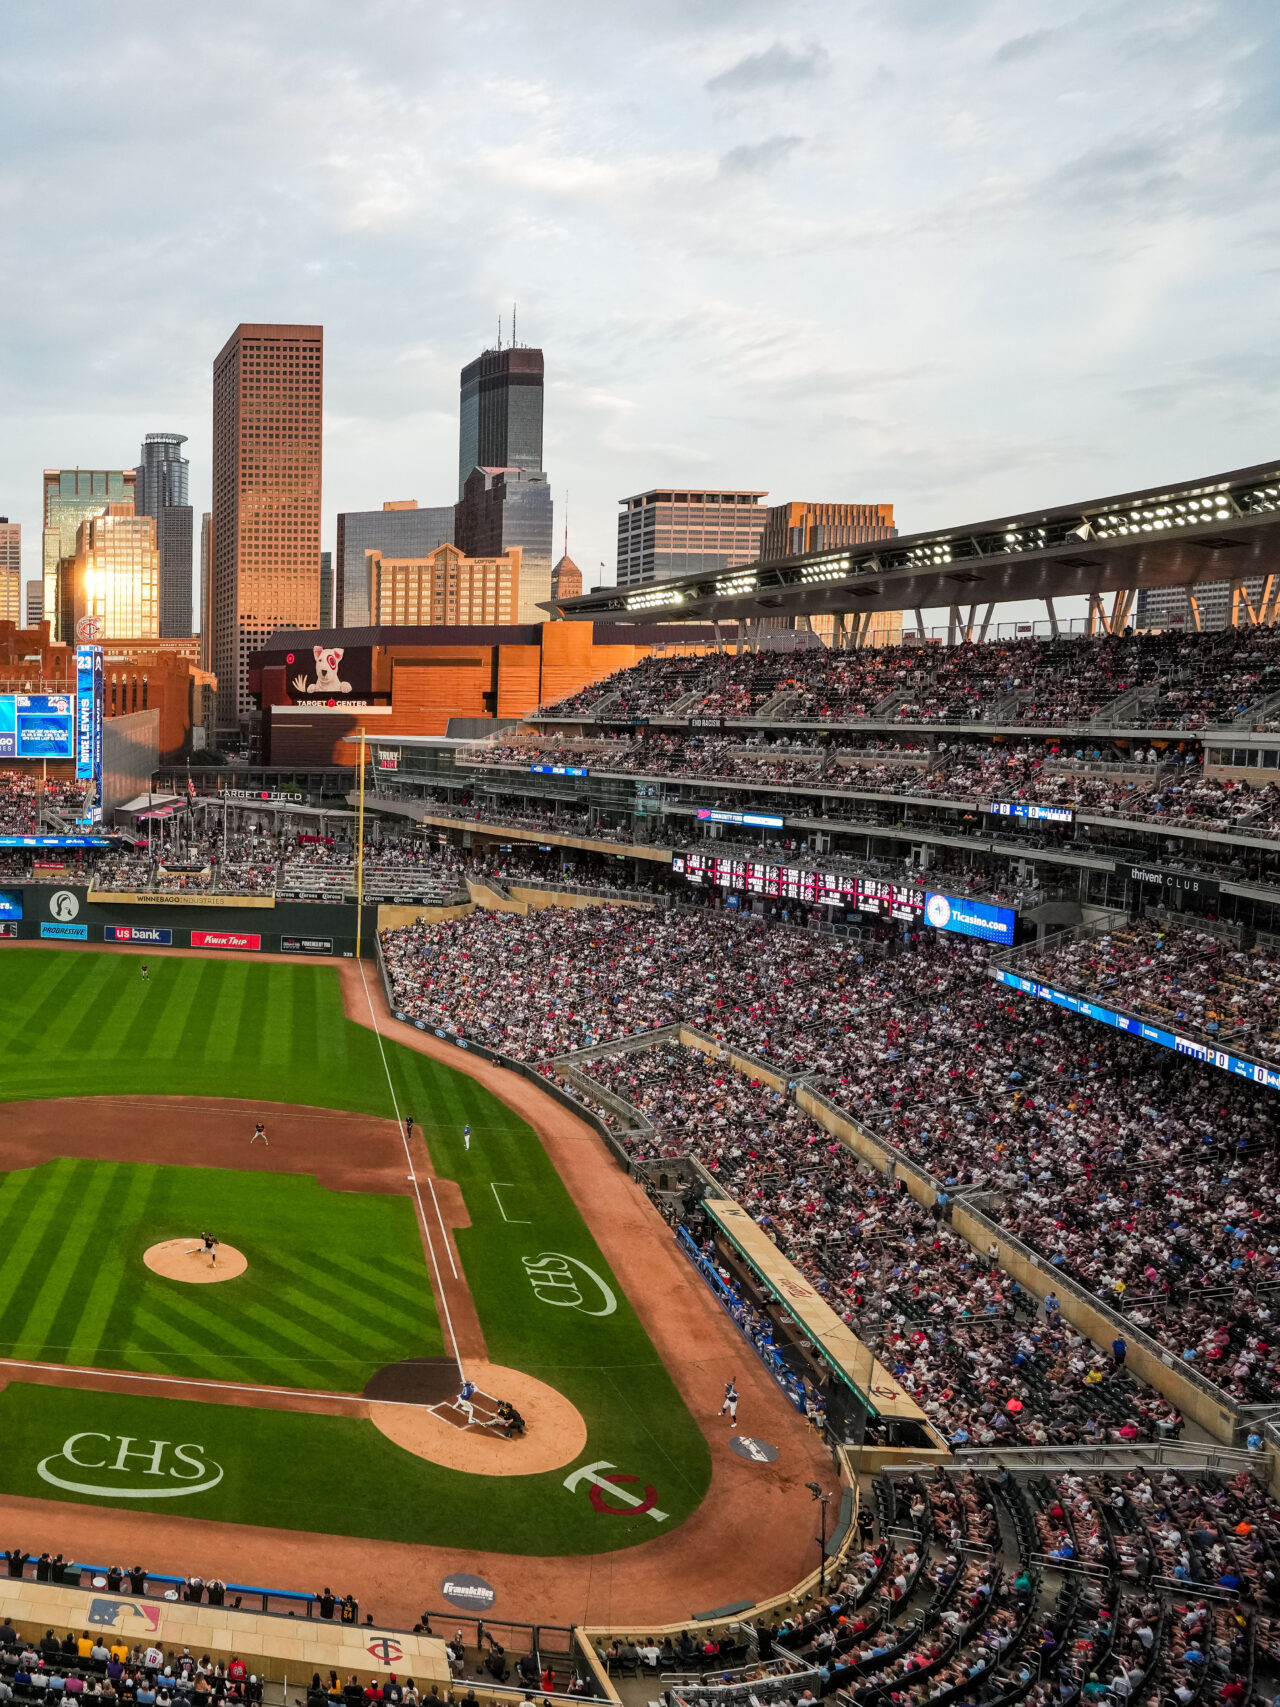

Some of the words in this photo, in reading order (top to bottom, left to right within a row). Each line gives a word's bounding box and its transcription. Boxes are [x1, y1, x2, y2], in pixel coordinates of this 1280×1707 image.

[77, 656, 92, 669] 23
[81, 698, 90, 740] LEWIS
[691, 719, 701, 727] END
[701, 719, 721, 727] RACISM
[80, 739, 90, 763] ROYCE
[378, 751, 399, 760] TRULY
[218, 789, 258, 798] TARGET
[271, 792, 302, 801] FIELD
[1131, 868, 1162, 884] thrivent
[1166, 877, 1199, 892] CLUB
[422, 897, 443, 905] Corona
[951, 910, 1007, 932] TIcasino.com
[42, 926, 86, 936] PROGRESSIVE
[115, 929, 130, 939] us
[131, 929, 161, 940] bank
[1207, 1049, 1215, 1062] P
[521, 1256, 583, 1307] CHS
[62, 1432, 206, 1479] CHS
[443, 1582, 494, 1598] Franklin
[343, 1610, 352, 1619] 54
[148, 1654, 157, 1664] 18
